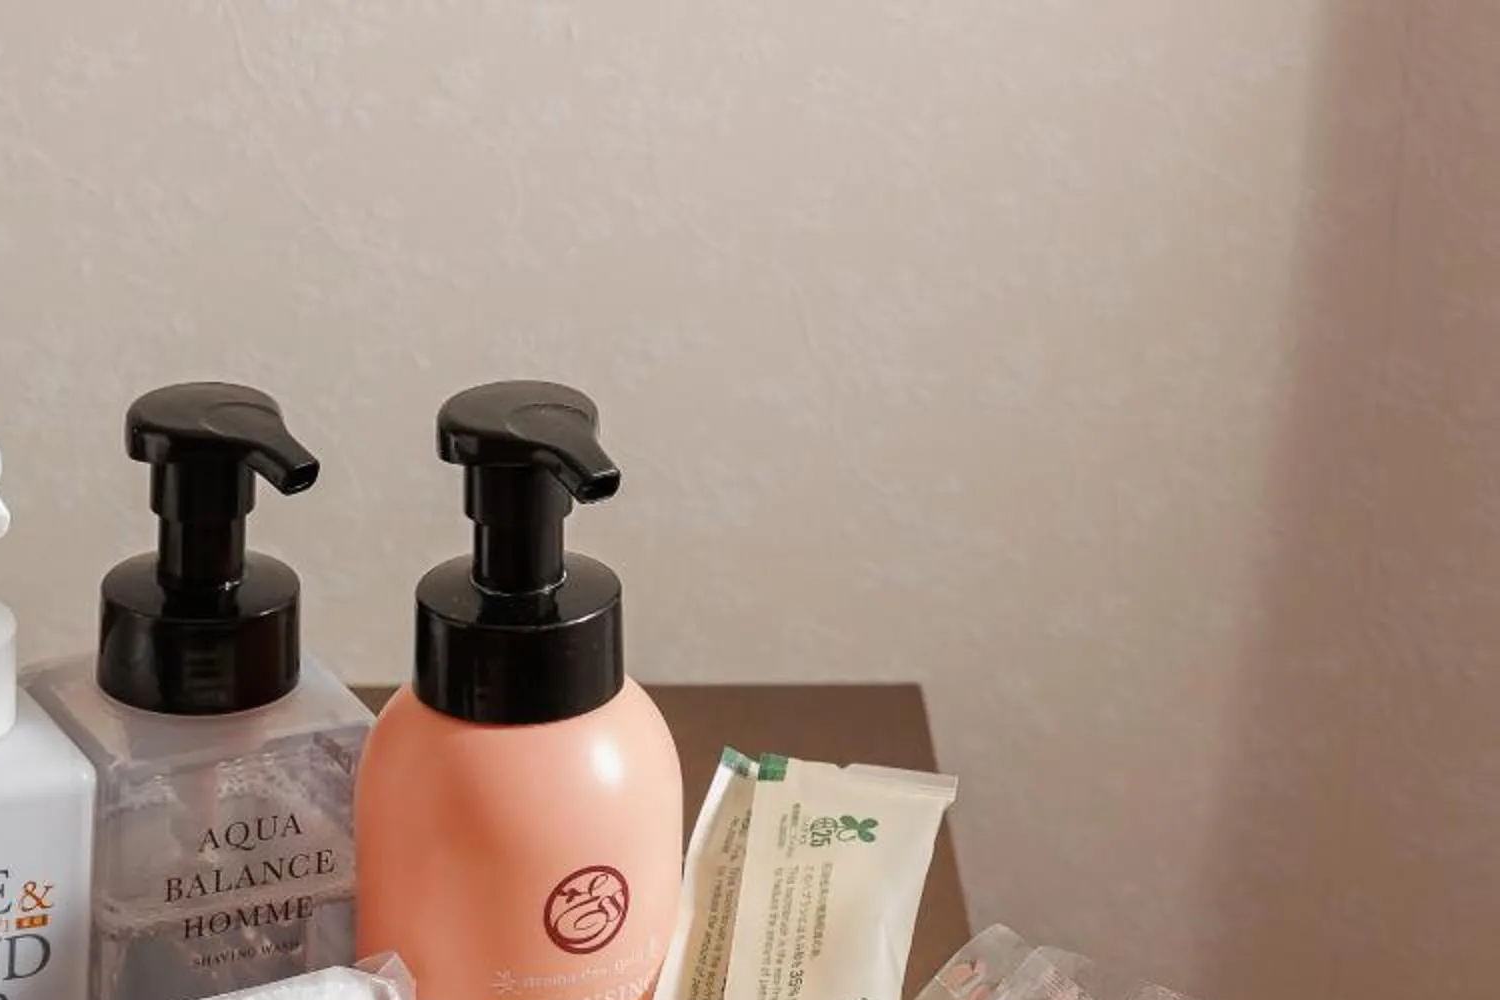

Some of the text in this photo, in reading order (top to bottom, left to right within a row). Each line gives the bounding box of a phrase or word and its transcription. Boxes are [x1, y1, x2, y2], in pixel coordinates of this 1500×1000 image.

[197, 813, 304, 853] AQUA
[16, 880, 54, 913] &
[164, 849, 336, 903] BALANCE
[182, 894, 316, 941] HOMME
